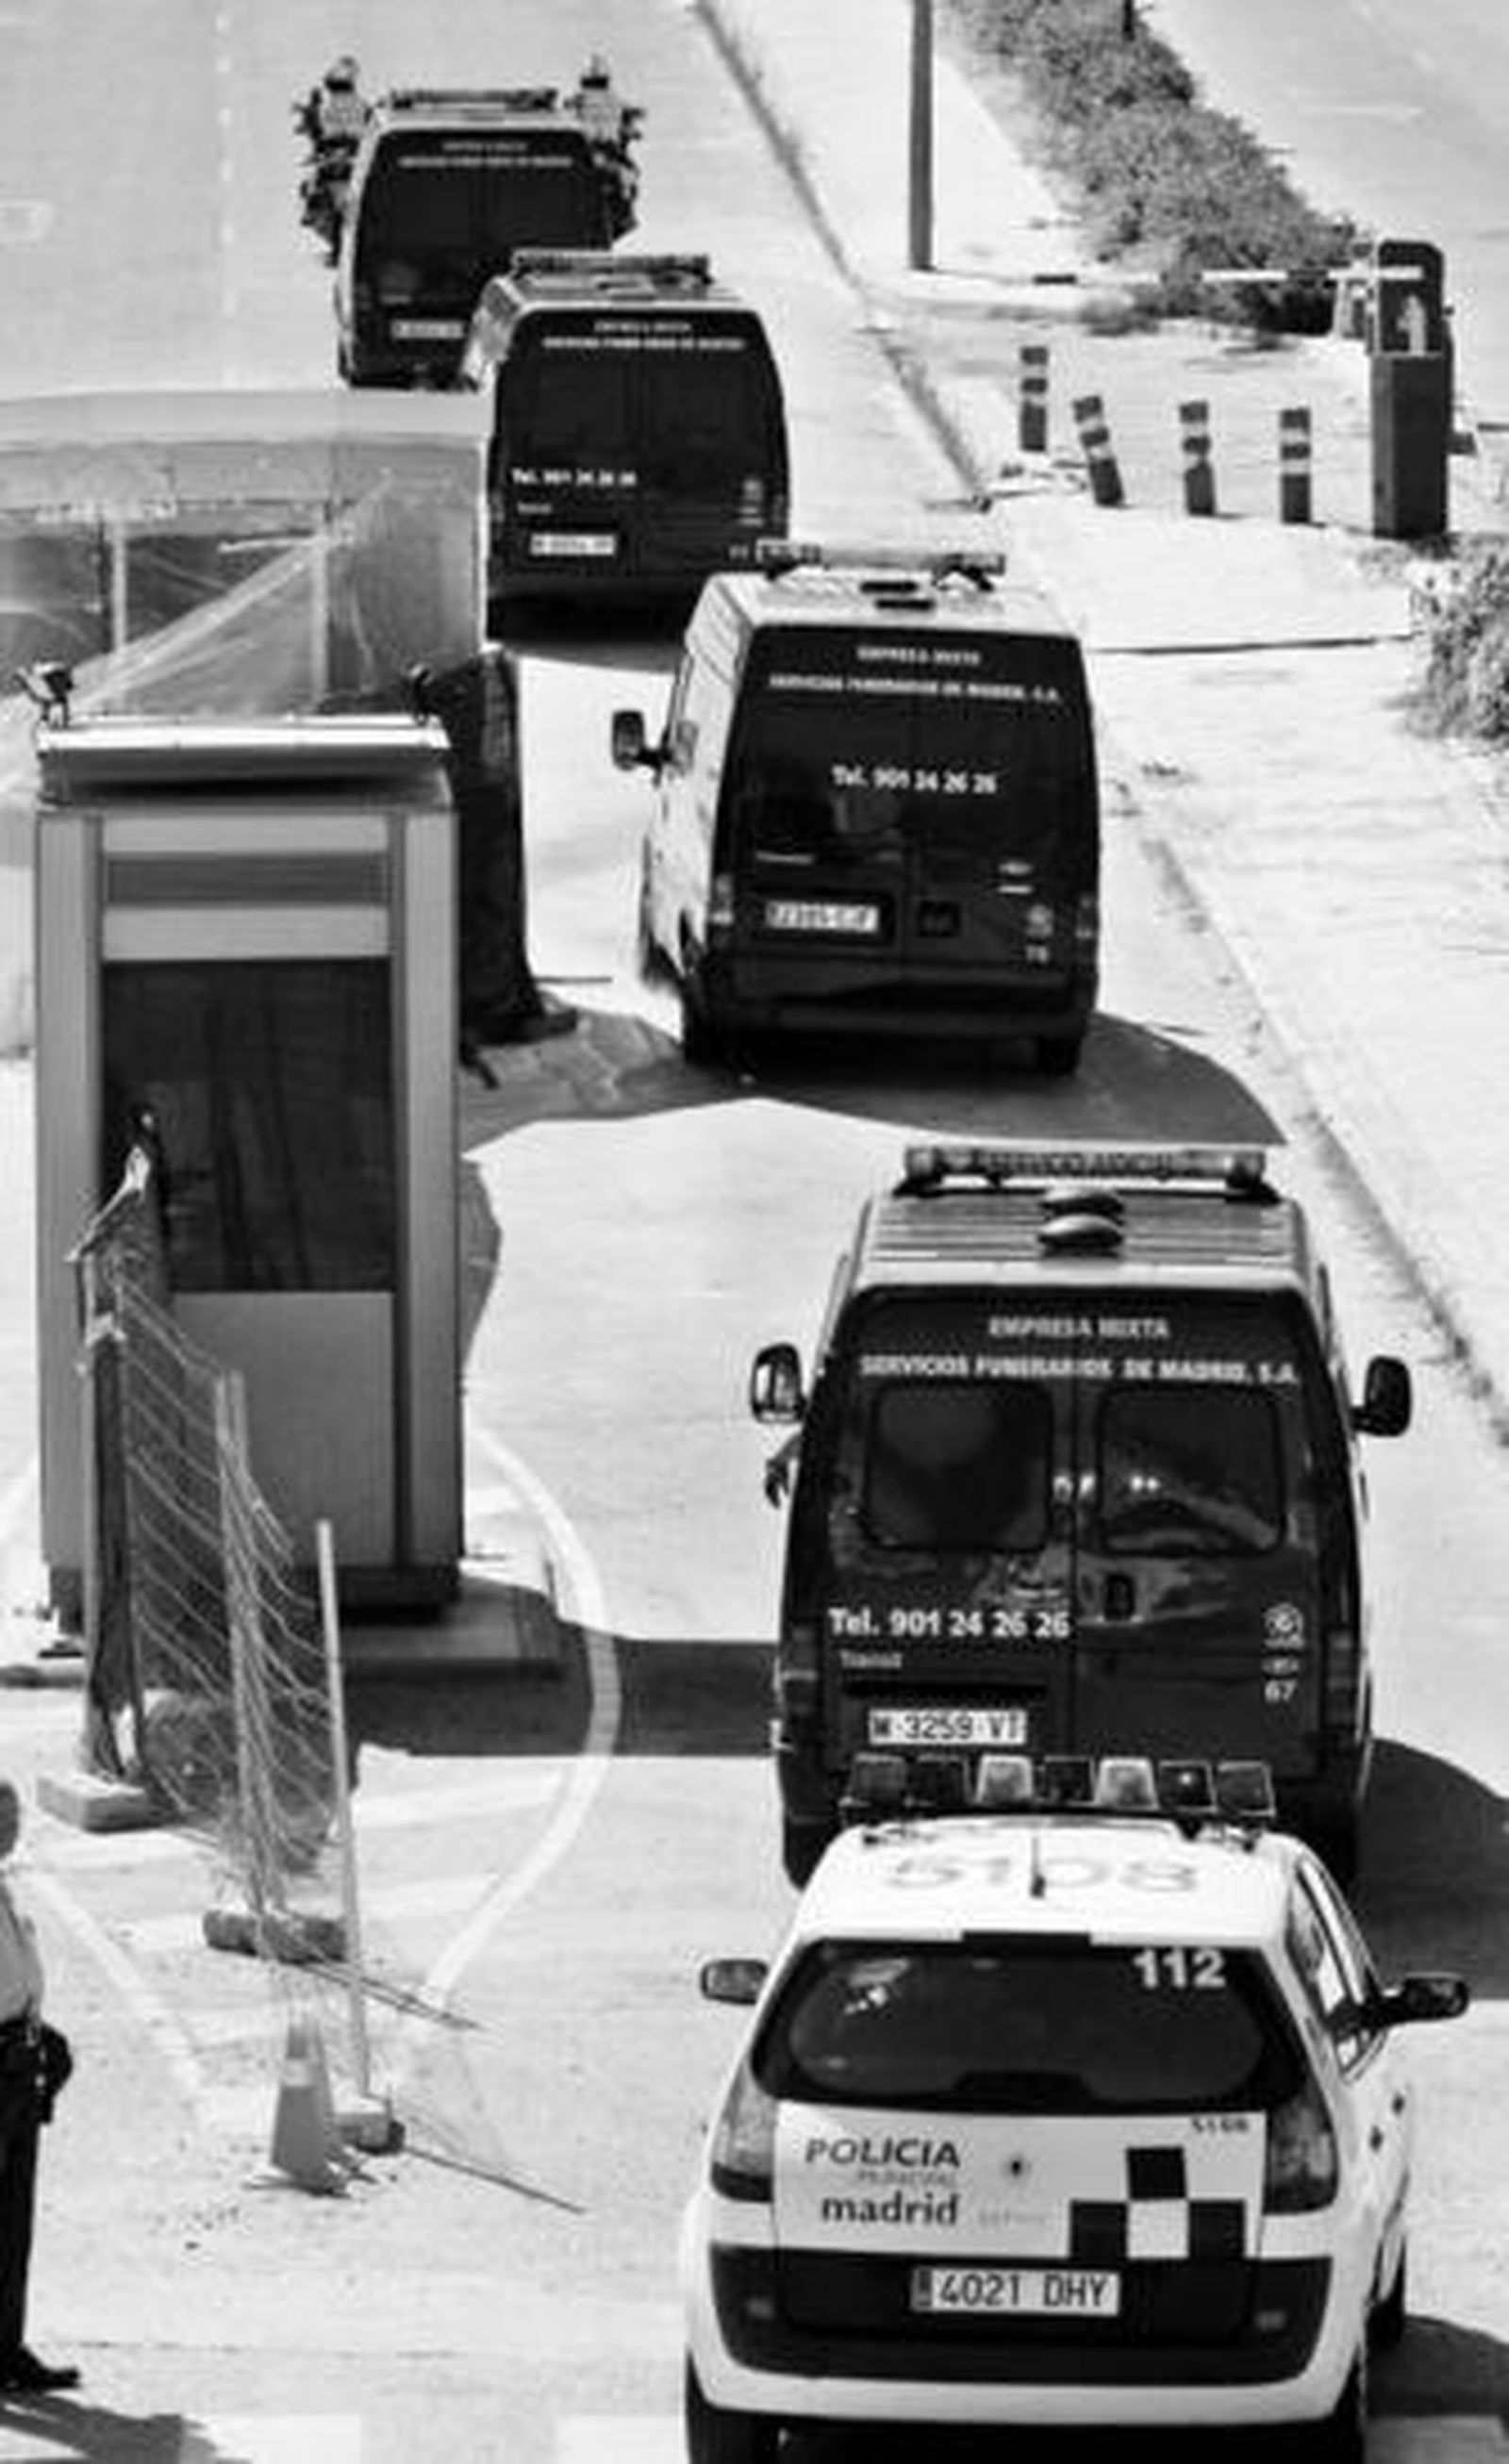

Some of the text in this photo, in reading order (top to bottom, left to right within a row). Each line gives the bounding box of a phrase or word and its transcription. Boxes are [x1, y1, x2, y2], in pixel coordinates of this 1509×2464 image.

[831, 764, 869, 786] Tel.
[871, 766, 910, 789] 901
[989, 1315, 1169, 1340] EMPRESA MIXTA
[860, 1354, 969, 1377] SERVICIOS
[975, 1355, 1112, 1380] FUNERARIOS
[1123, 1359, 1153, 1380] DE
[828, 1607, 1071, 1639] Tel. 901 24 26 26
[1134, 1948, 1226, 1988] 112
[821, 2190, 960, 2227] madrid
[940, 2273, 1107, 2307] 4021 DHY
